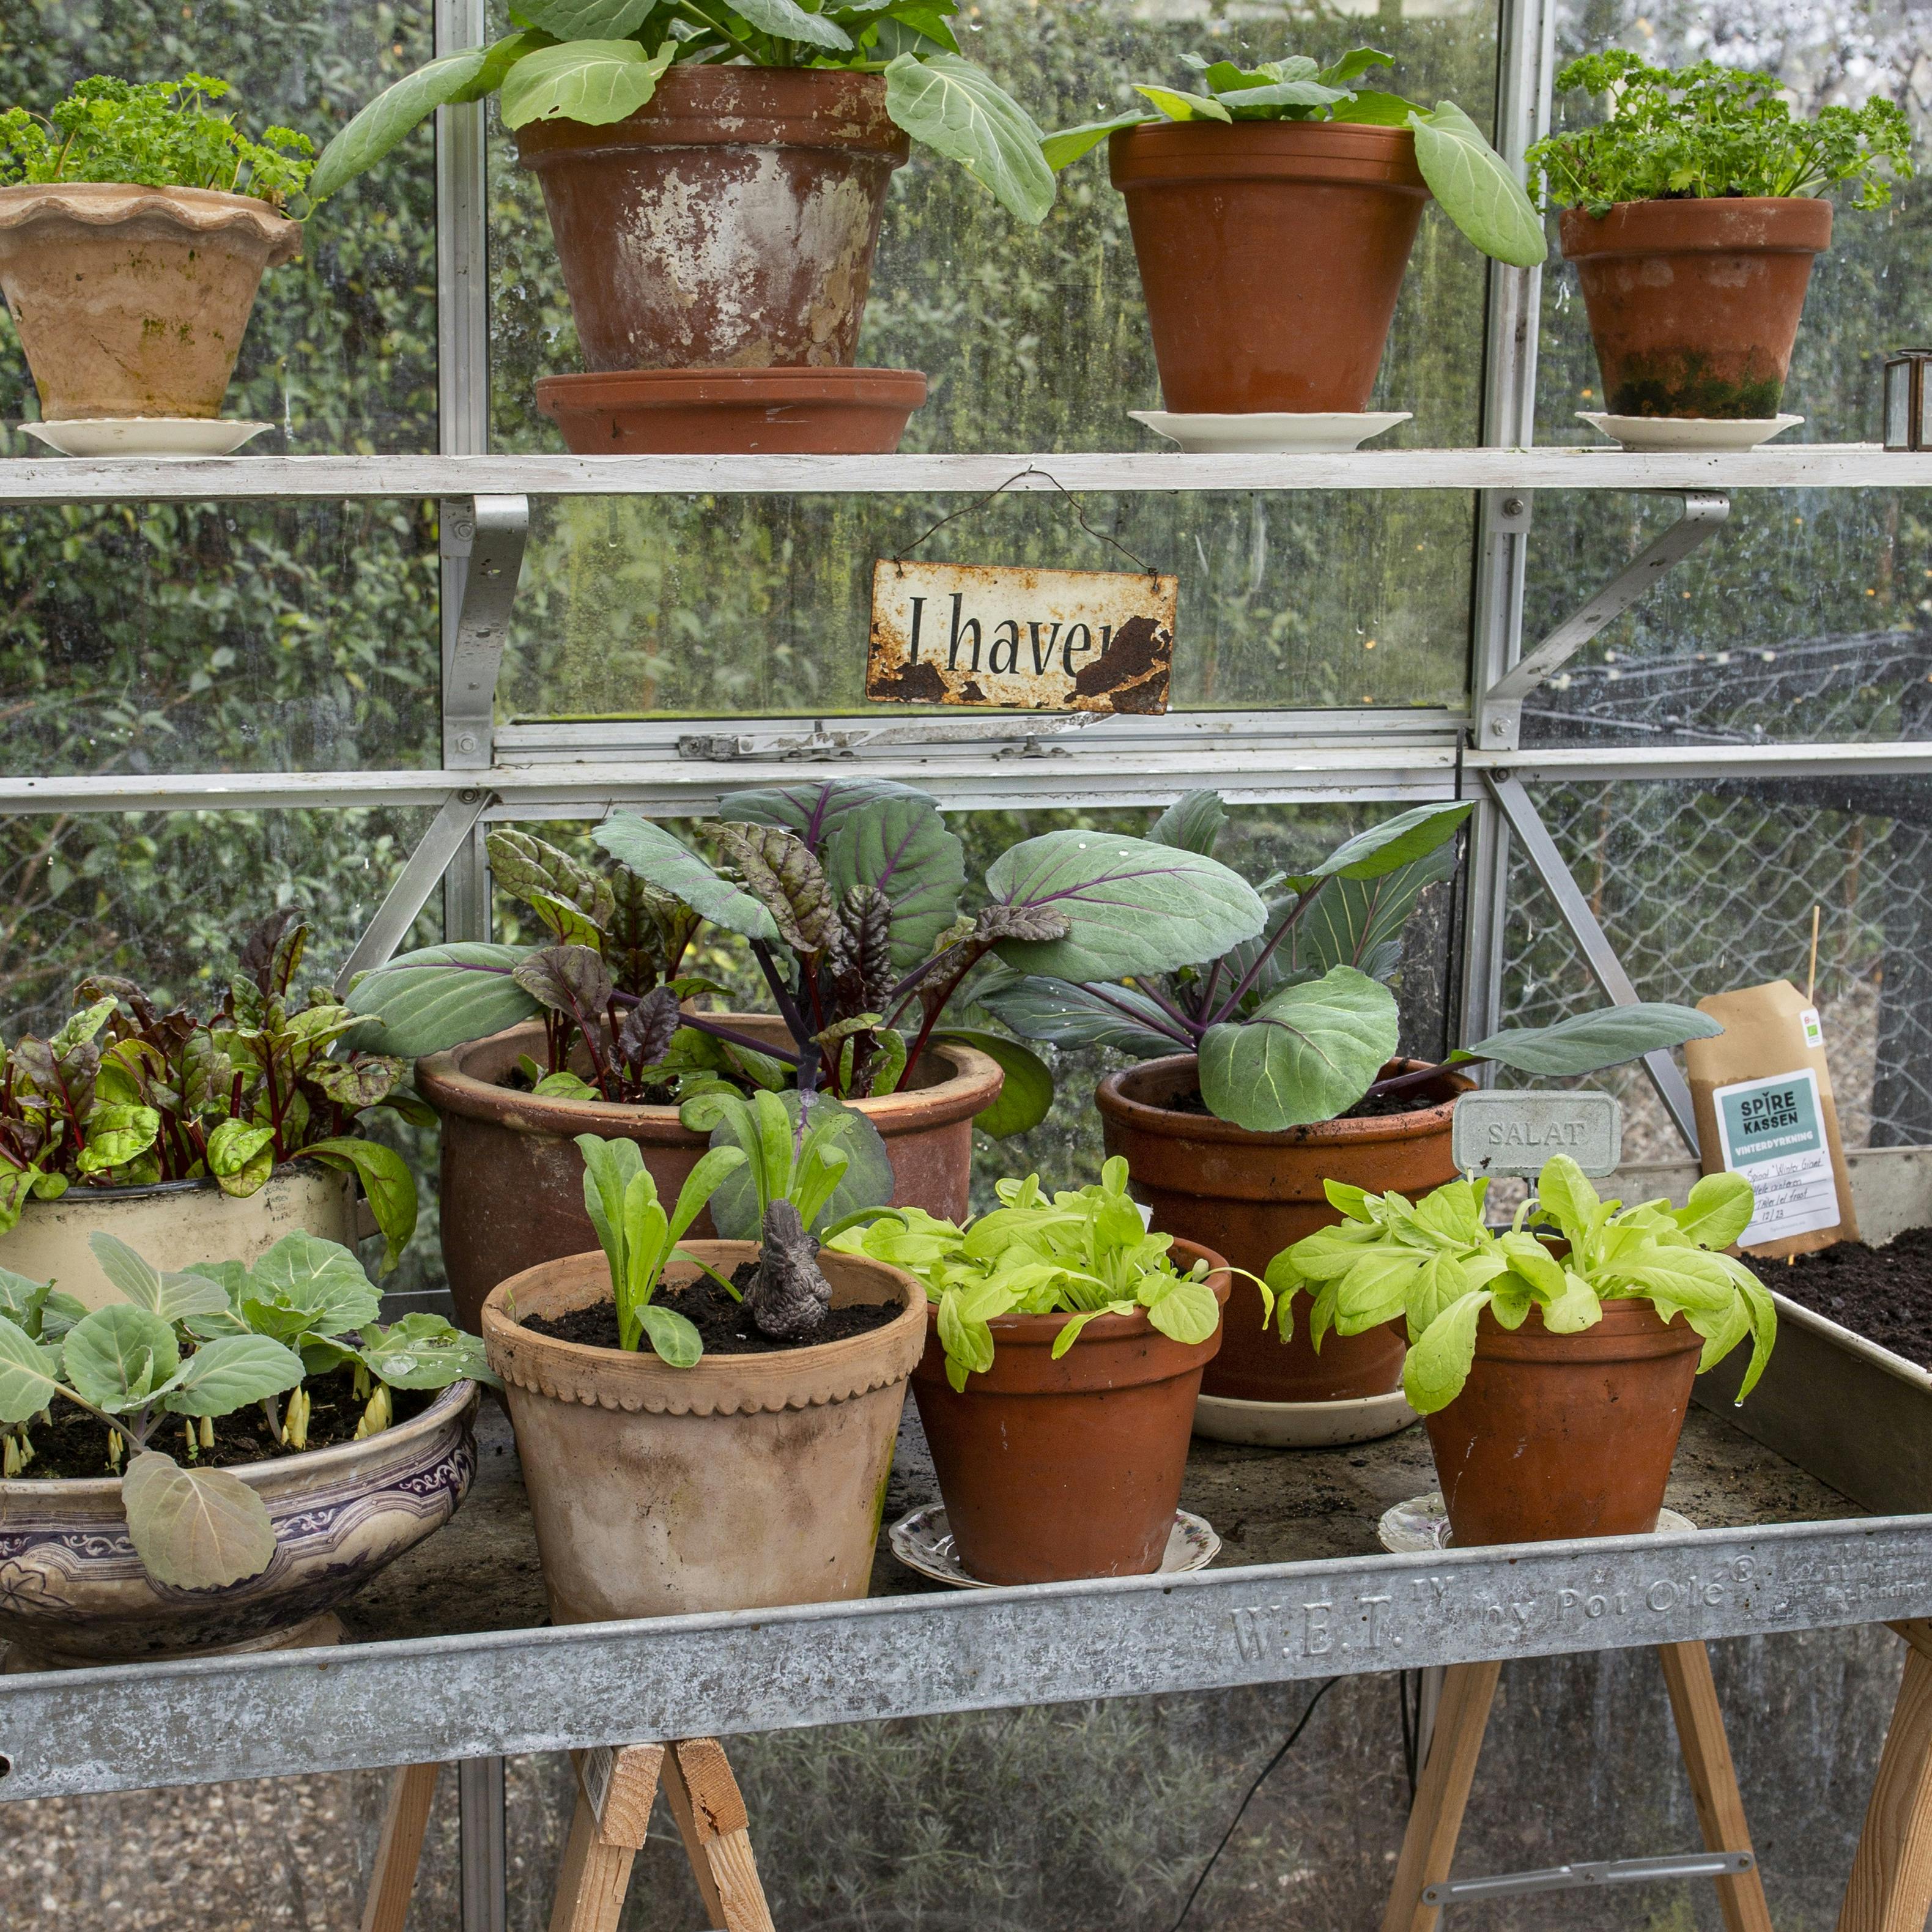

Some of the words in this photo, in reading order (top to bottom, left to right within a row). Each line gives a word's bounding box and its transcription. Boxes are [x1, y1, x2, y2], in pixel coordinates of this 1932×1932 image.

[909, 596, 928, 667] I
[1741, 1091, 1796, 1116] SPIRE
[1488, 1121, 1585, 1146] SALAT
[1744, 1111, 1798, 1135] KASSEN
[1735, 1131, 1813, 1156] VINTERDYRKNING
[1481, 1593, 1534, 1633] by
[1556, 1588, 1628, 1622] Pot
